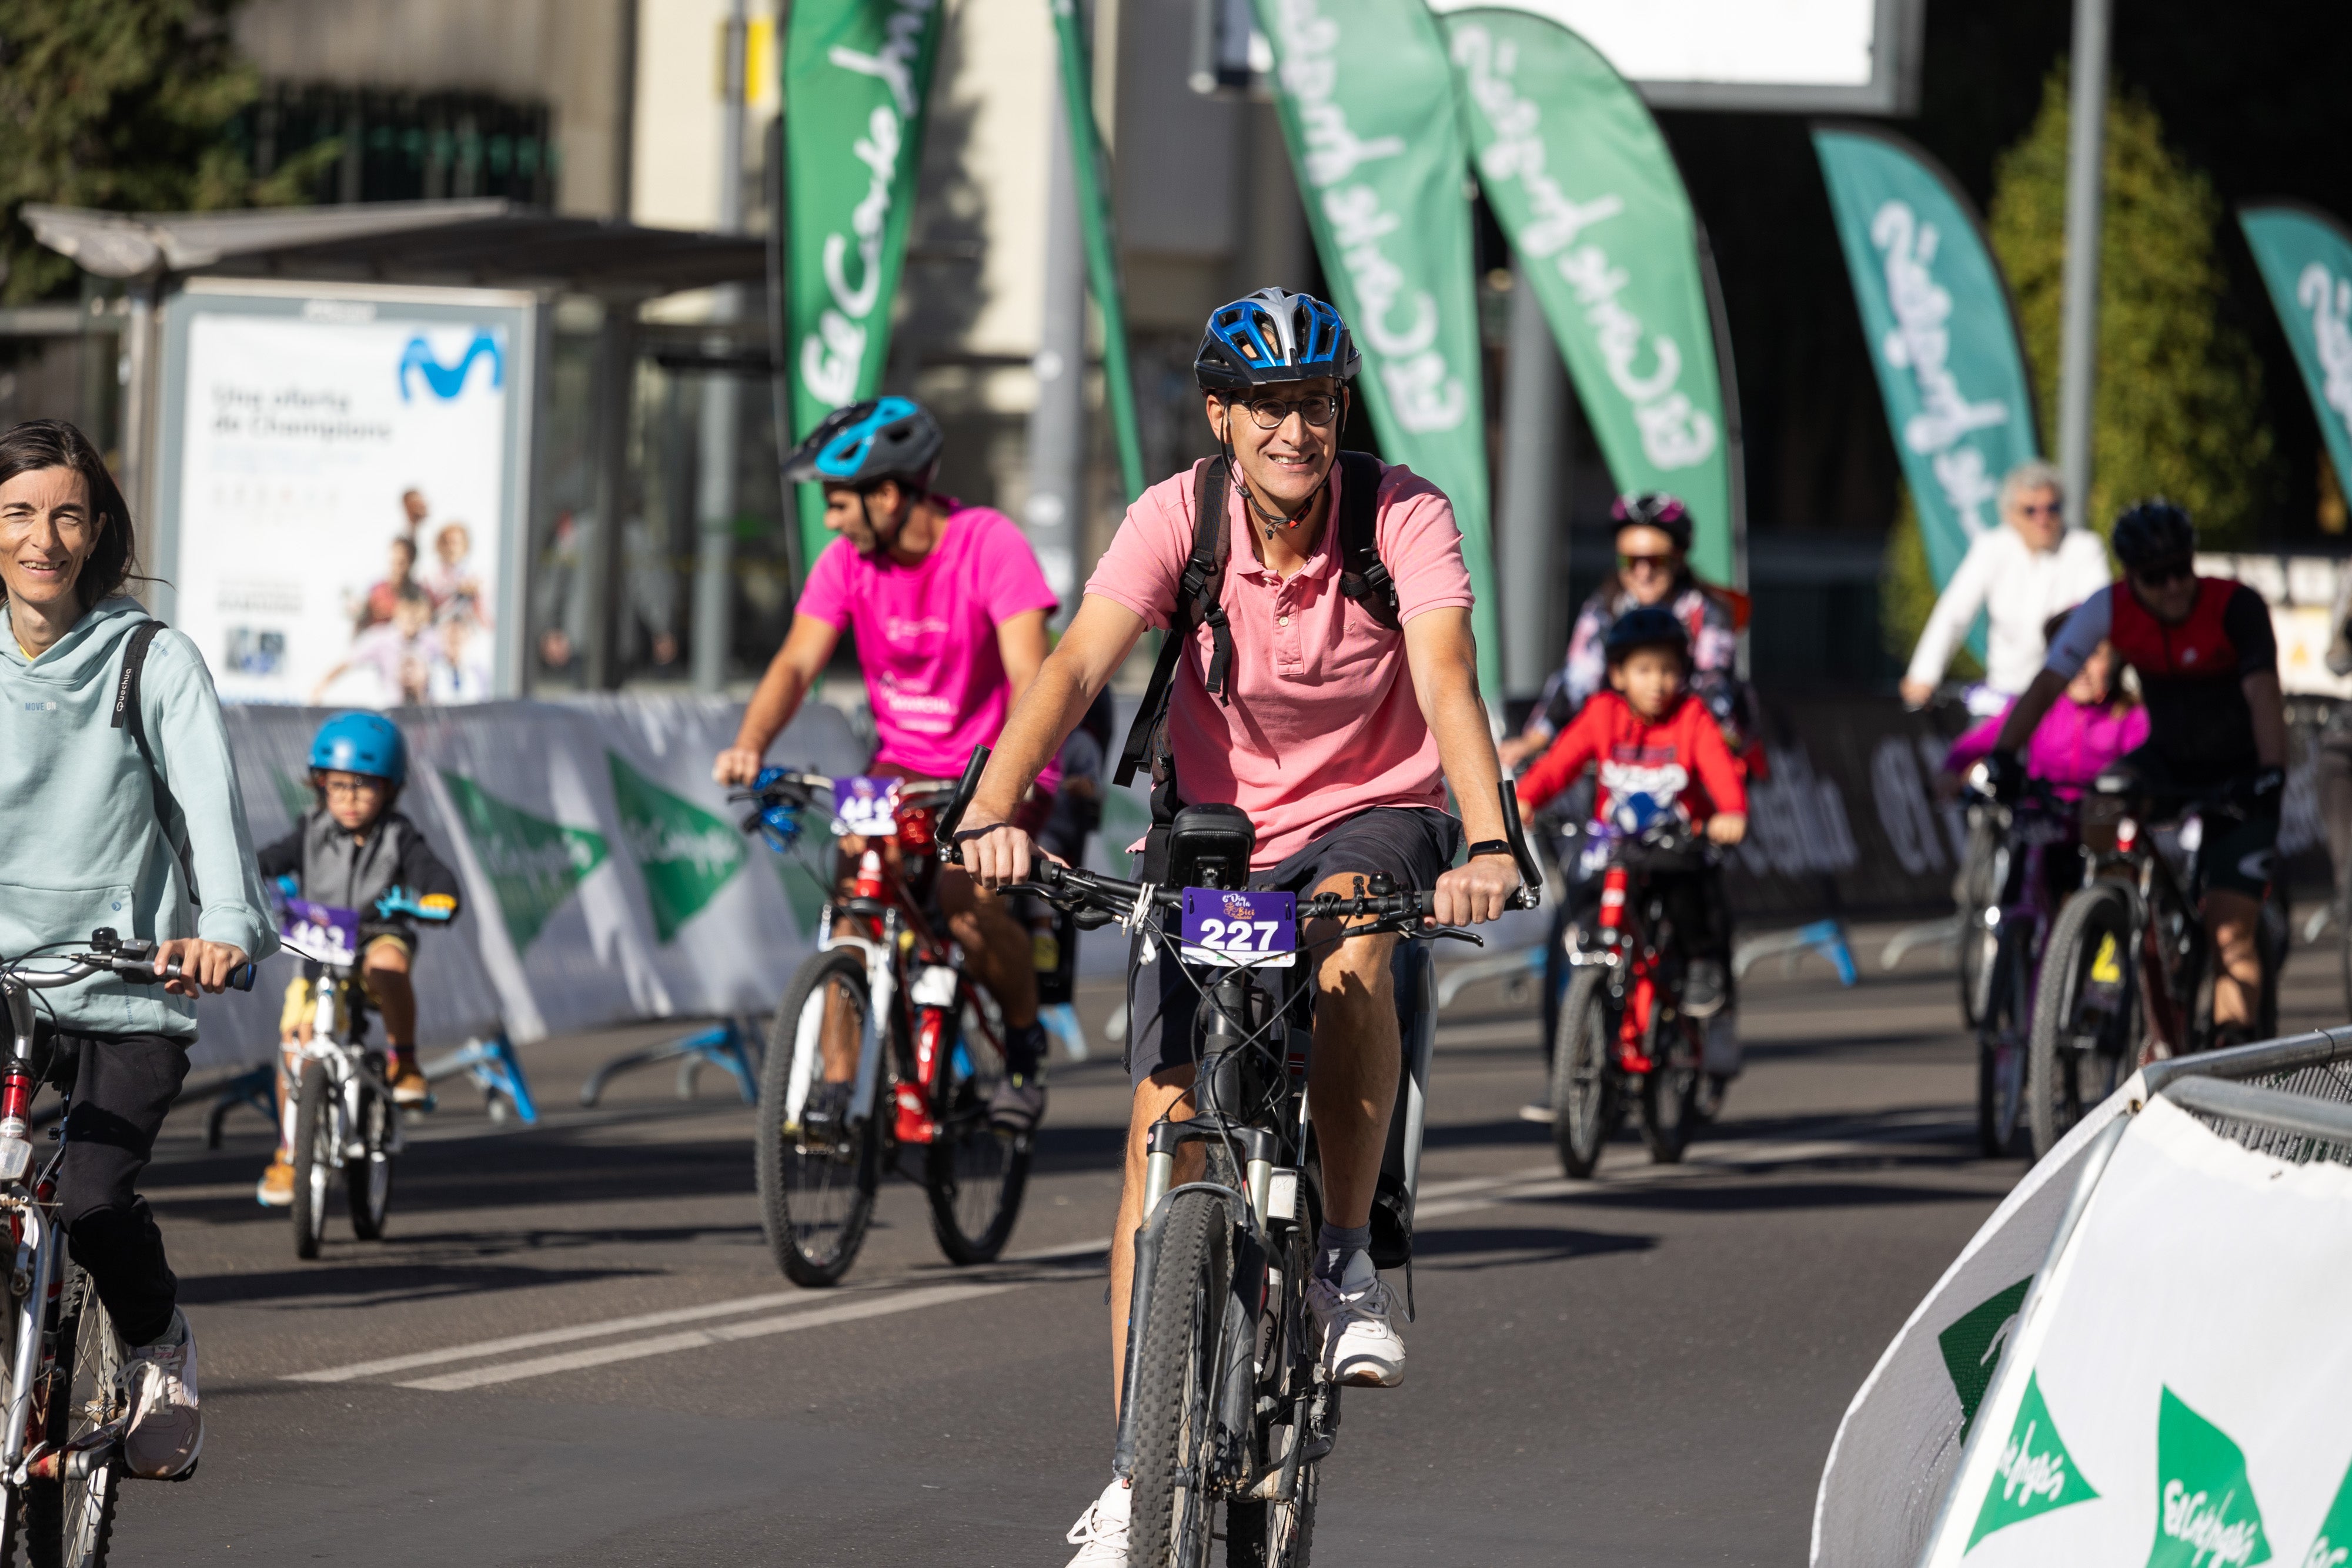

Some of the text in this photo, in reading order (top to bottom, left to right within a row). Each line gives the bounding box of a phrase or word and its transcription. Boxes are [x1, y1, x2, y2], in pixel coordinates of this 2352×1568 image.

[116, 668, 132, 712] Quechua
[25, 702, 56, 711] MOVE ON
[1237, 907, 1255, 916] Bici
[1200, 918, 1278, 951] 227
